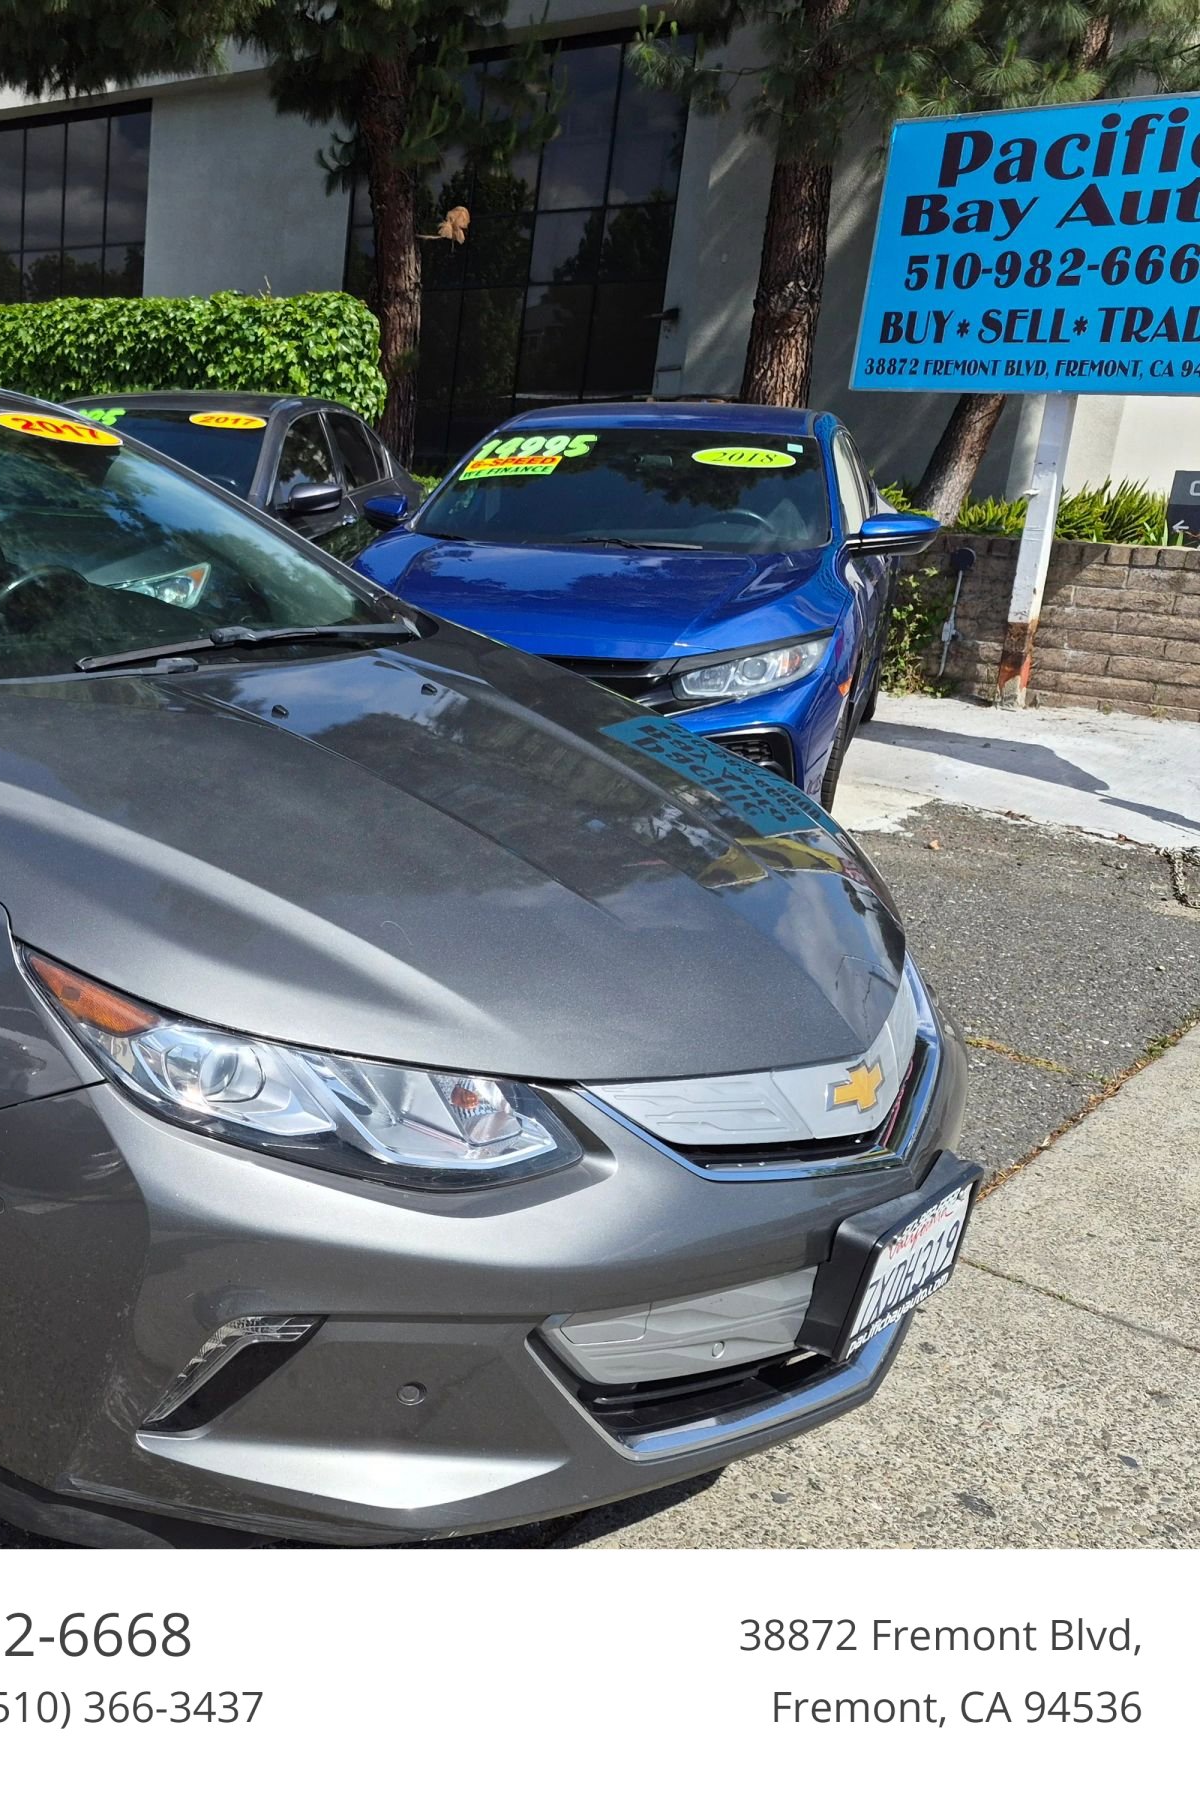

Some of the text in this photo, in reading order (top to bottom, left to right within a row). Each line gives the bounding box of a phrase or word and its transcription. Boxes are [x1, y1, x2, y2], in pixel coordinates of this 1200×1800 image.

[937, 107, 1200, 188] Pacifi
[900, 193, 1040, 242] Bay
[879, 310, 955, 344] BUY
[977, 308, 1070, 344] SELL
[864, 358, 920, 376] 38872
[923, 359, 1001, 377] FREMONT
[1004, 359, 1049, 379] BLVD,
[1054, 359, 1143, 380] FREMONT,
[1149, 360, 1174, 378] CA
[11, 416, 100, 440] 2017
[201, 415, 257, 427] 2017
[474, 434, 598, 462] 14995
[711, 451, 778, 464] 2018
[470, 456, 558, 470] 6-SPEED
[485, 464, 551, 476] FINANCE
